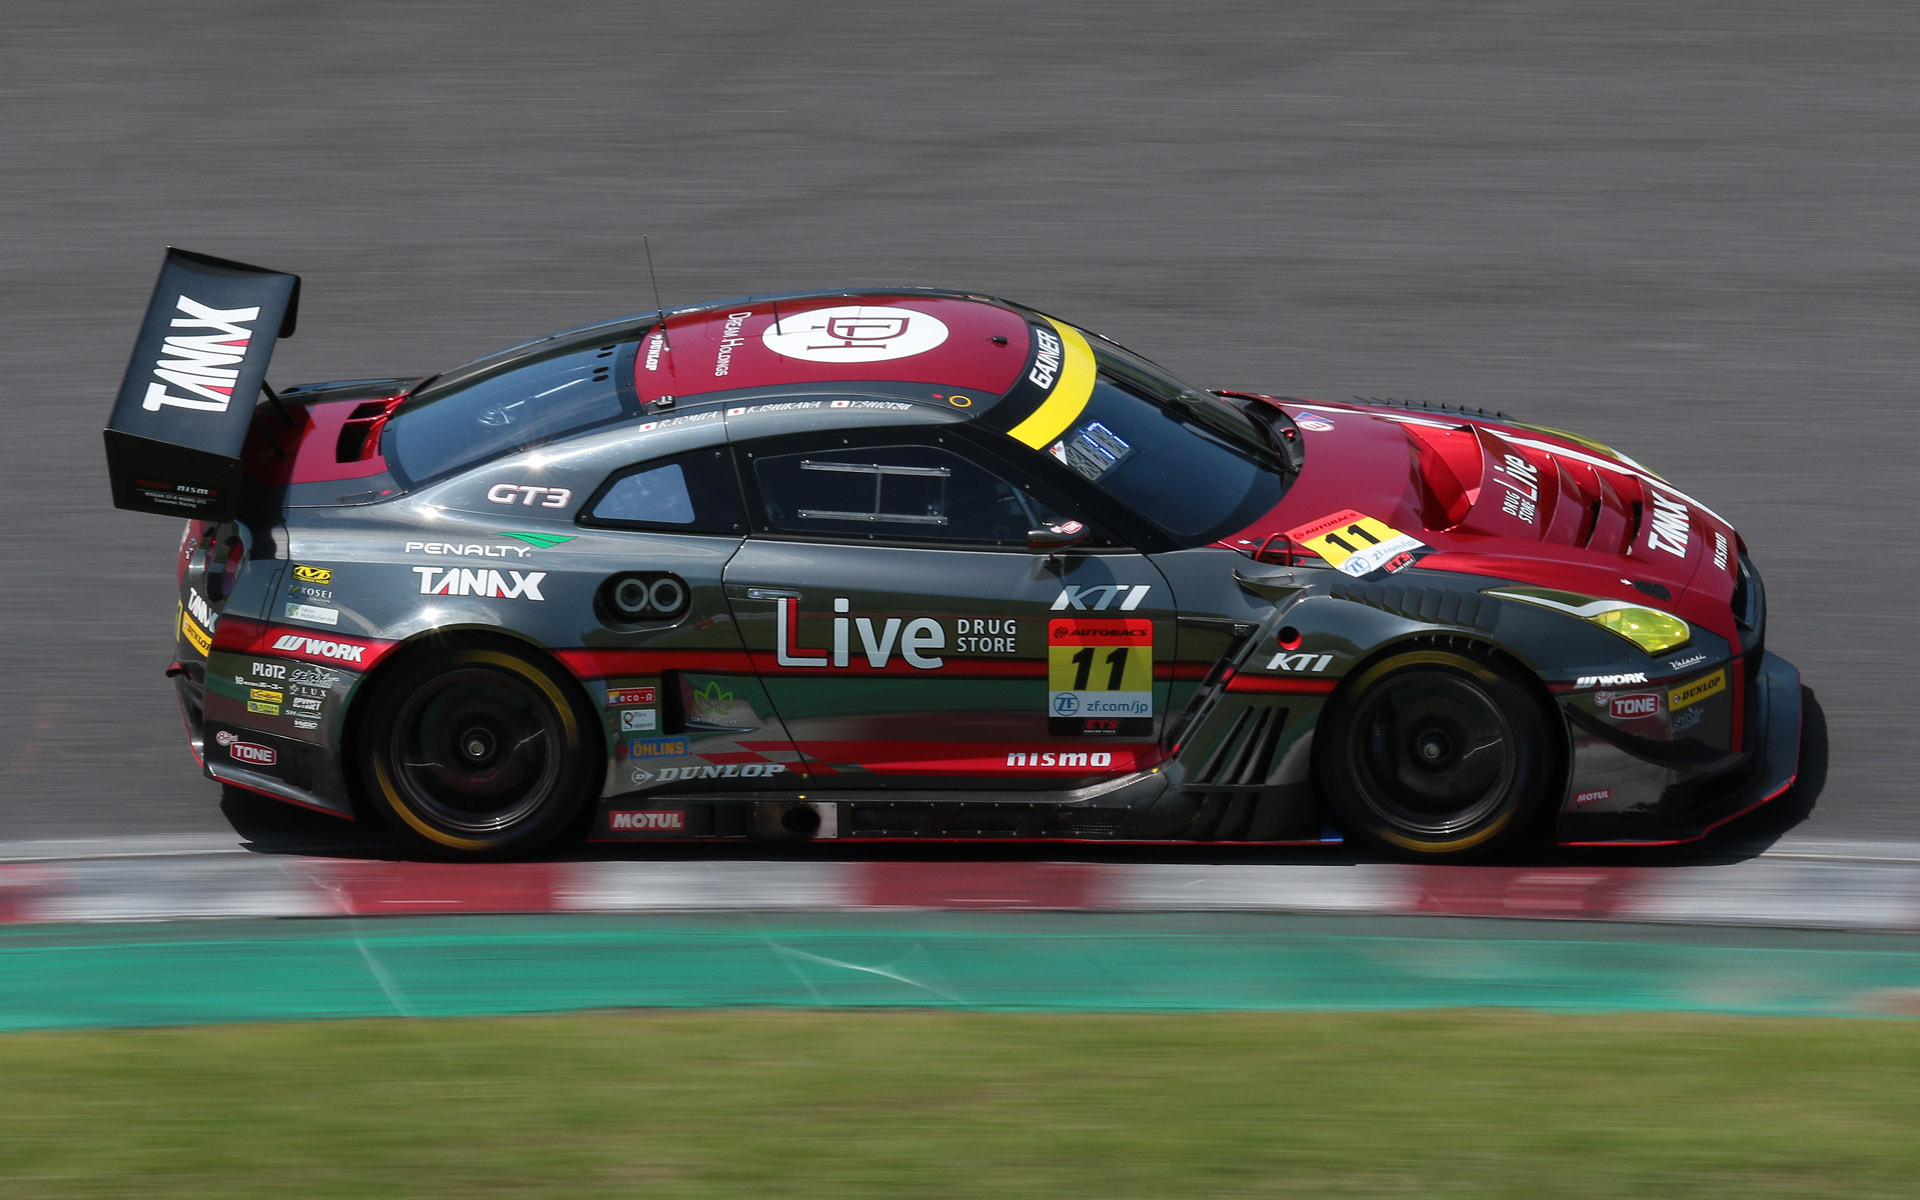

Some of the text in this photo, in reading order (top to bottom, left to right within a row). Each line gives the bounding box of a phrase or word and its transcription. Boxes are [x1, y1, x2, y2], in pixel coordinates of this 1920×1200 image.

[645, 339, 664, 371] DUNLOP
[1028, 328, 1061, 390] GAINER
[1492, 453, 1539, 502] Live
[486, 483, 573, 509] GT3
[1502, 489, 1521, 517] DRUG
[1518, 499, 1536, 525] STORE
[1305, 512, 1358, 536] AUTOBACS
[1324, 523, 1383, 554] 11
[404, 541, 532, 558] PENALTY
[1050, 585, 1152, 611] KTI
[777, 597, 946, 669] Live
[957, 618, 1017, 635] DRUG
[1070, 628, 1148, 637] AUTOBACS
[305, 639, 367, 662] WORK
[957, 636, 1017, 653] STORE
[1071, 647, 1129, 691] 11
[1265, 652, 1334, 672] KTI
[1598, 672, 1649, 685] WORK
[1682, 676, 1721, 701] DUNLOP
[1086, 701, 1149, 714] zf.com/jp
[1614, 697, 1656, 715] TONE
[234, 744, 273, 763] TONE
[633, 740, 686, 757] ÖHLINS
[1006, 752, 1112, 767] nismo
[655, 763, 787, 782] DUNLOP
[1577, 790, 1610, 803] MOTUL
[613, 813, 683, 828] MOTUL
